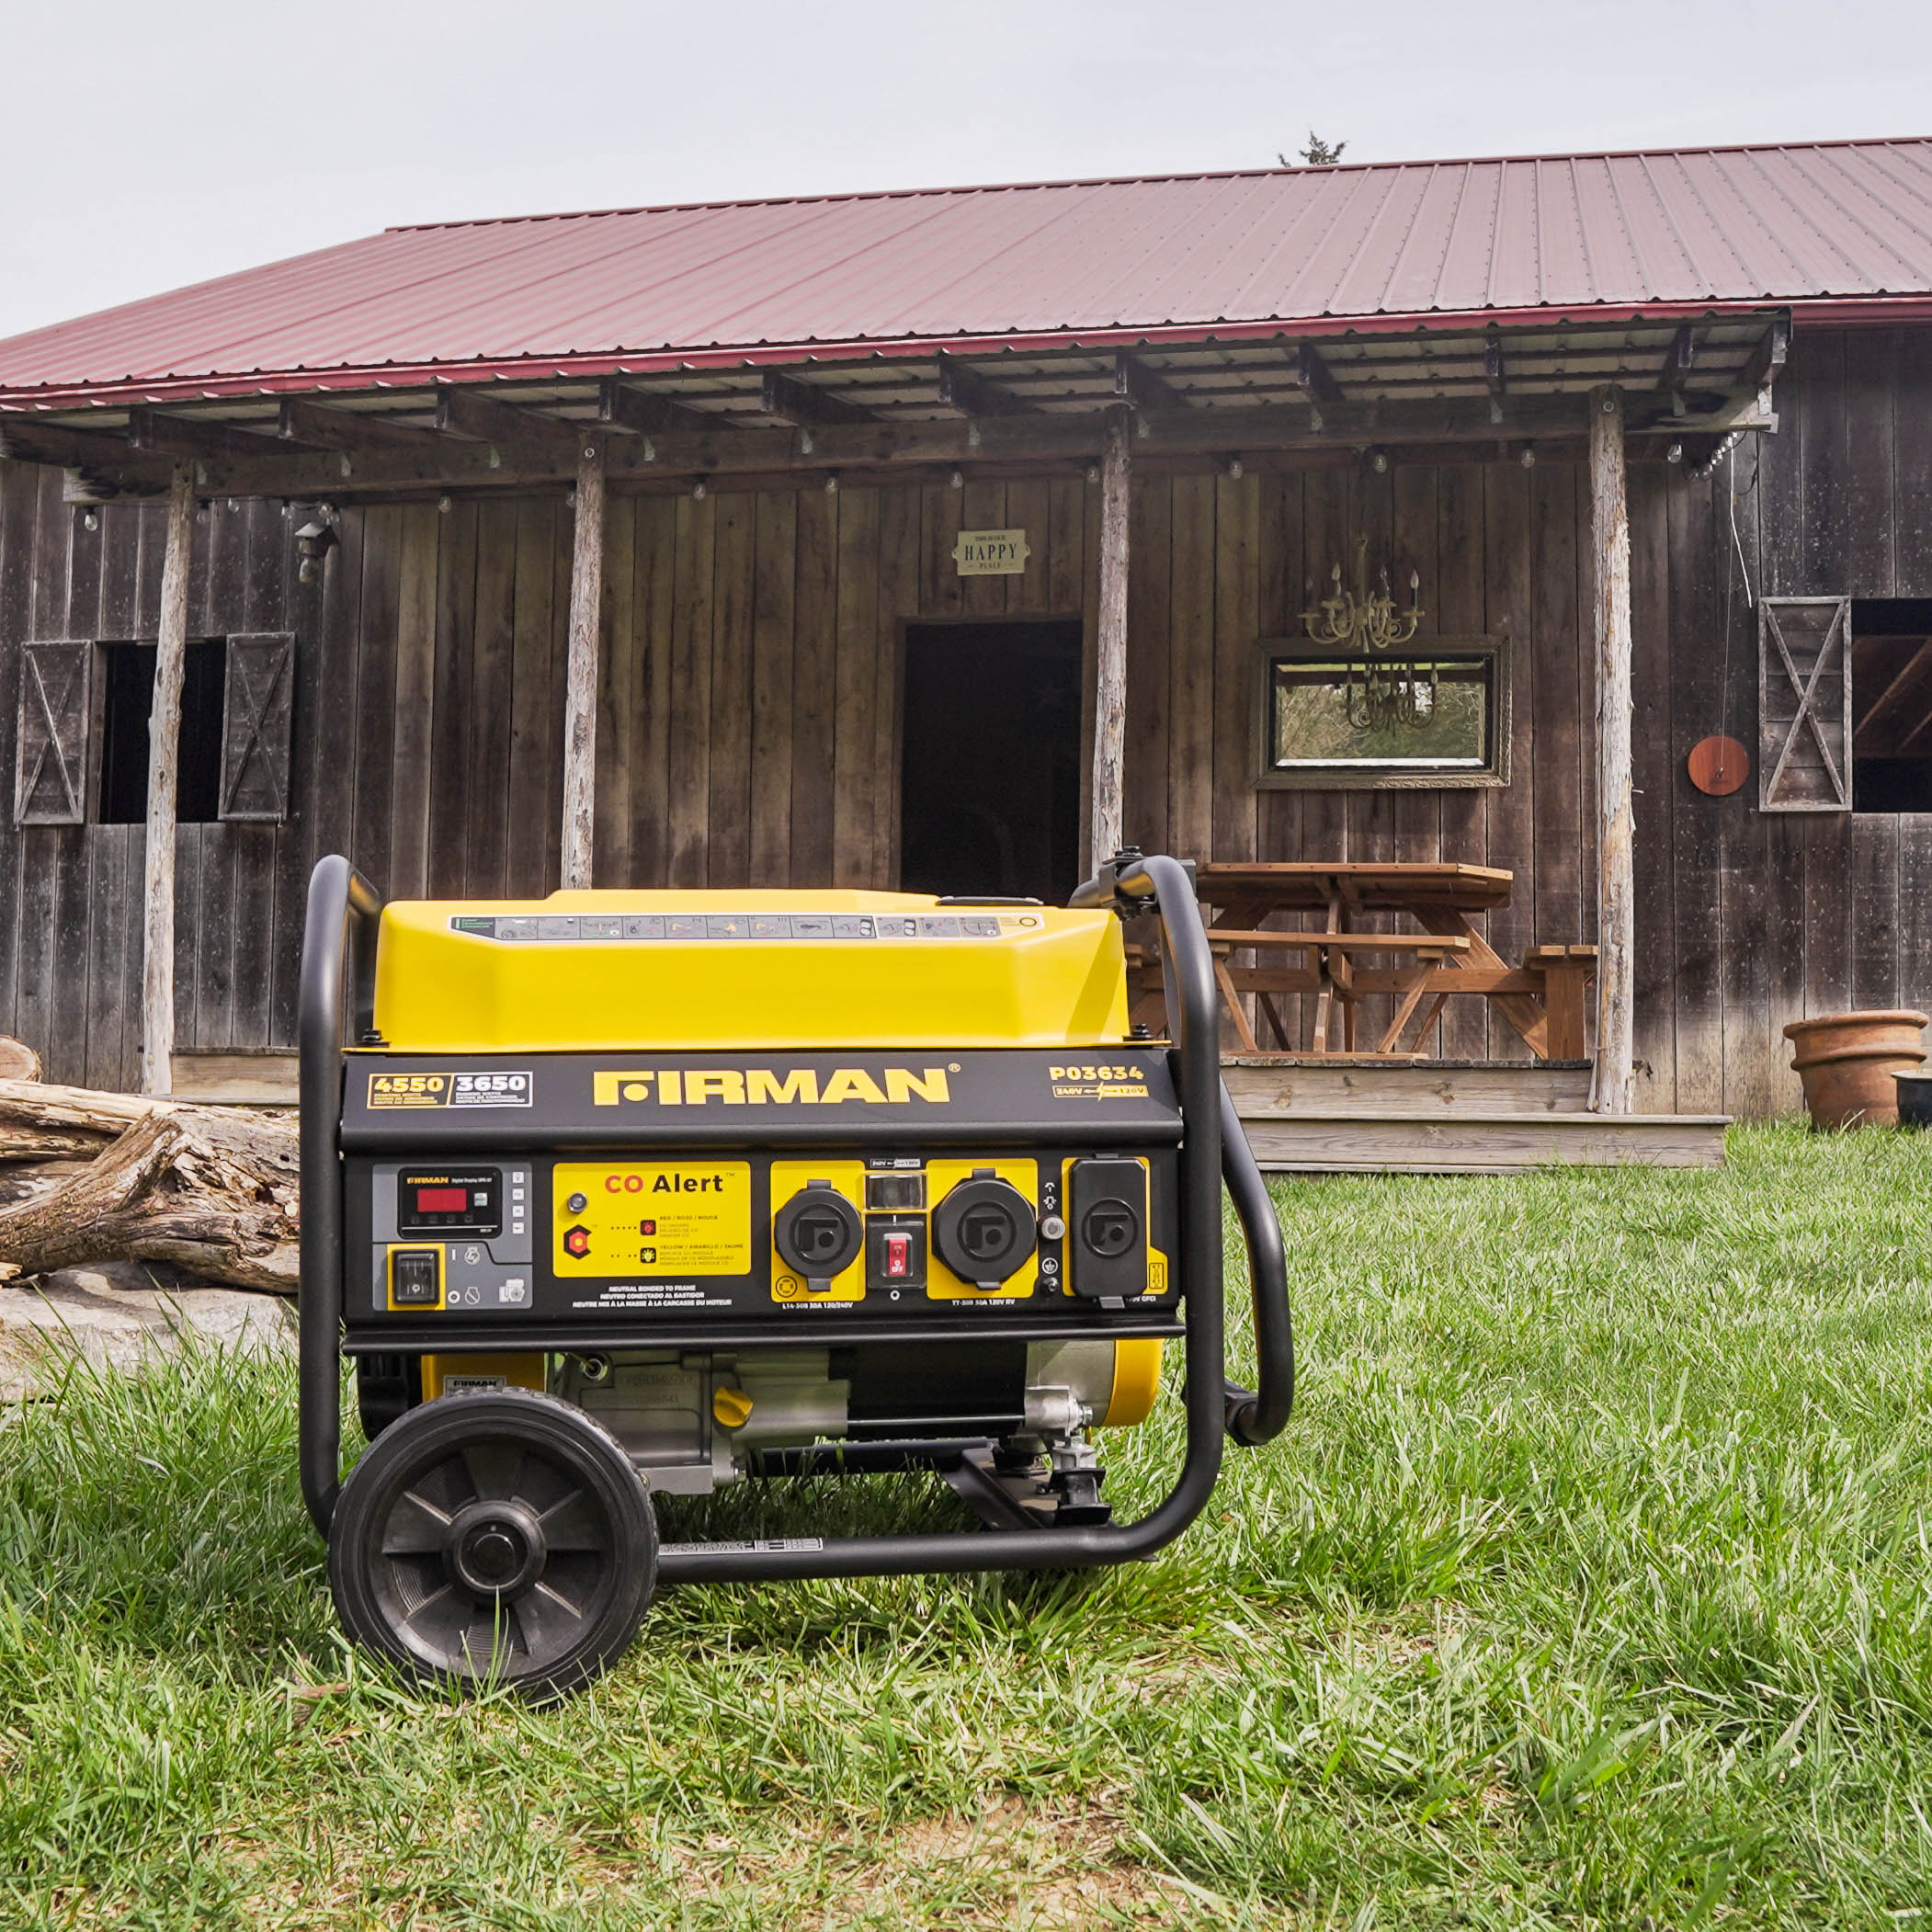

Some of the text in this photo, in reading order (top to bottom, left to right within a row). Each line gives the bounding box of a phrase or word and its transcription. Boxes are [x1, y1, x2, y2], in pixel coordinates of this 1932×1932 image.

[964, 543, 1017, 561] HAPPY
[1049, 1066, 1144, 1080] P03634
[374, 1076, 444, 1092] 4550
[456, 1075, 526, 1092] 3650
[593, 1068, 950, 1105] FIRMAN
[605, 1175, 643, 1193] CO
[652, 1173, 723, 1193] Alert
